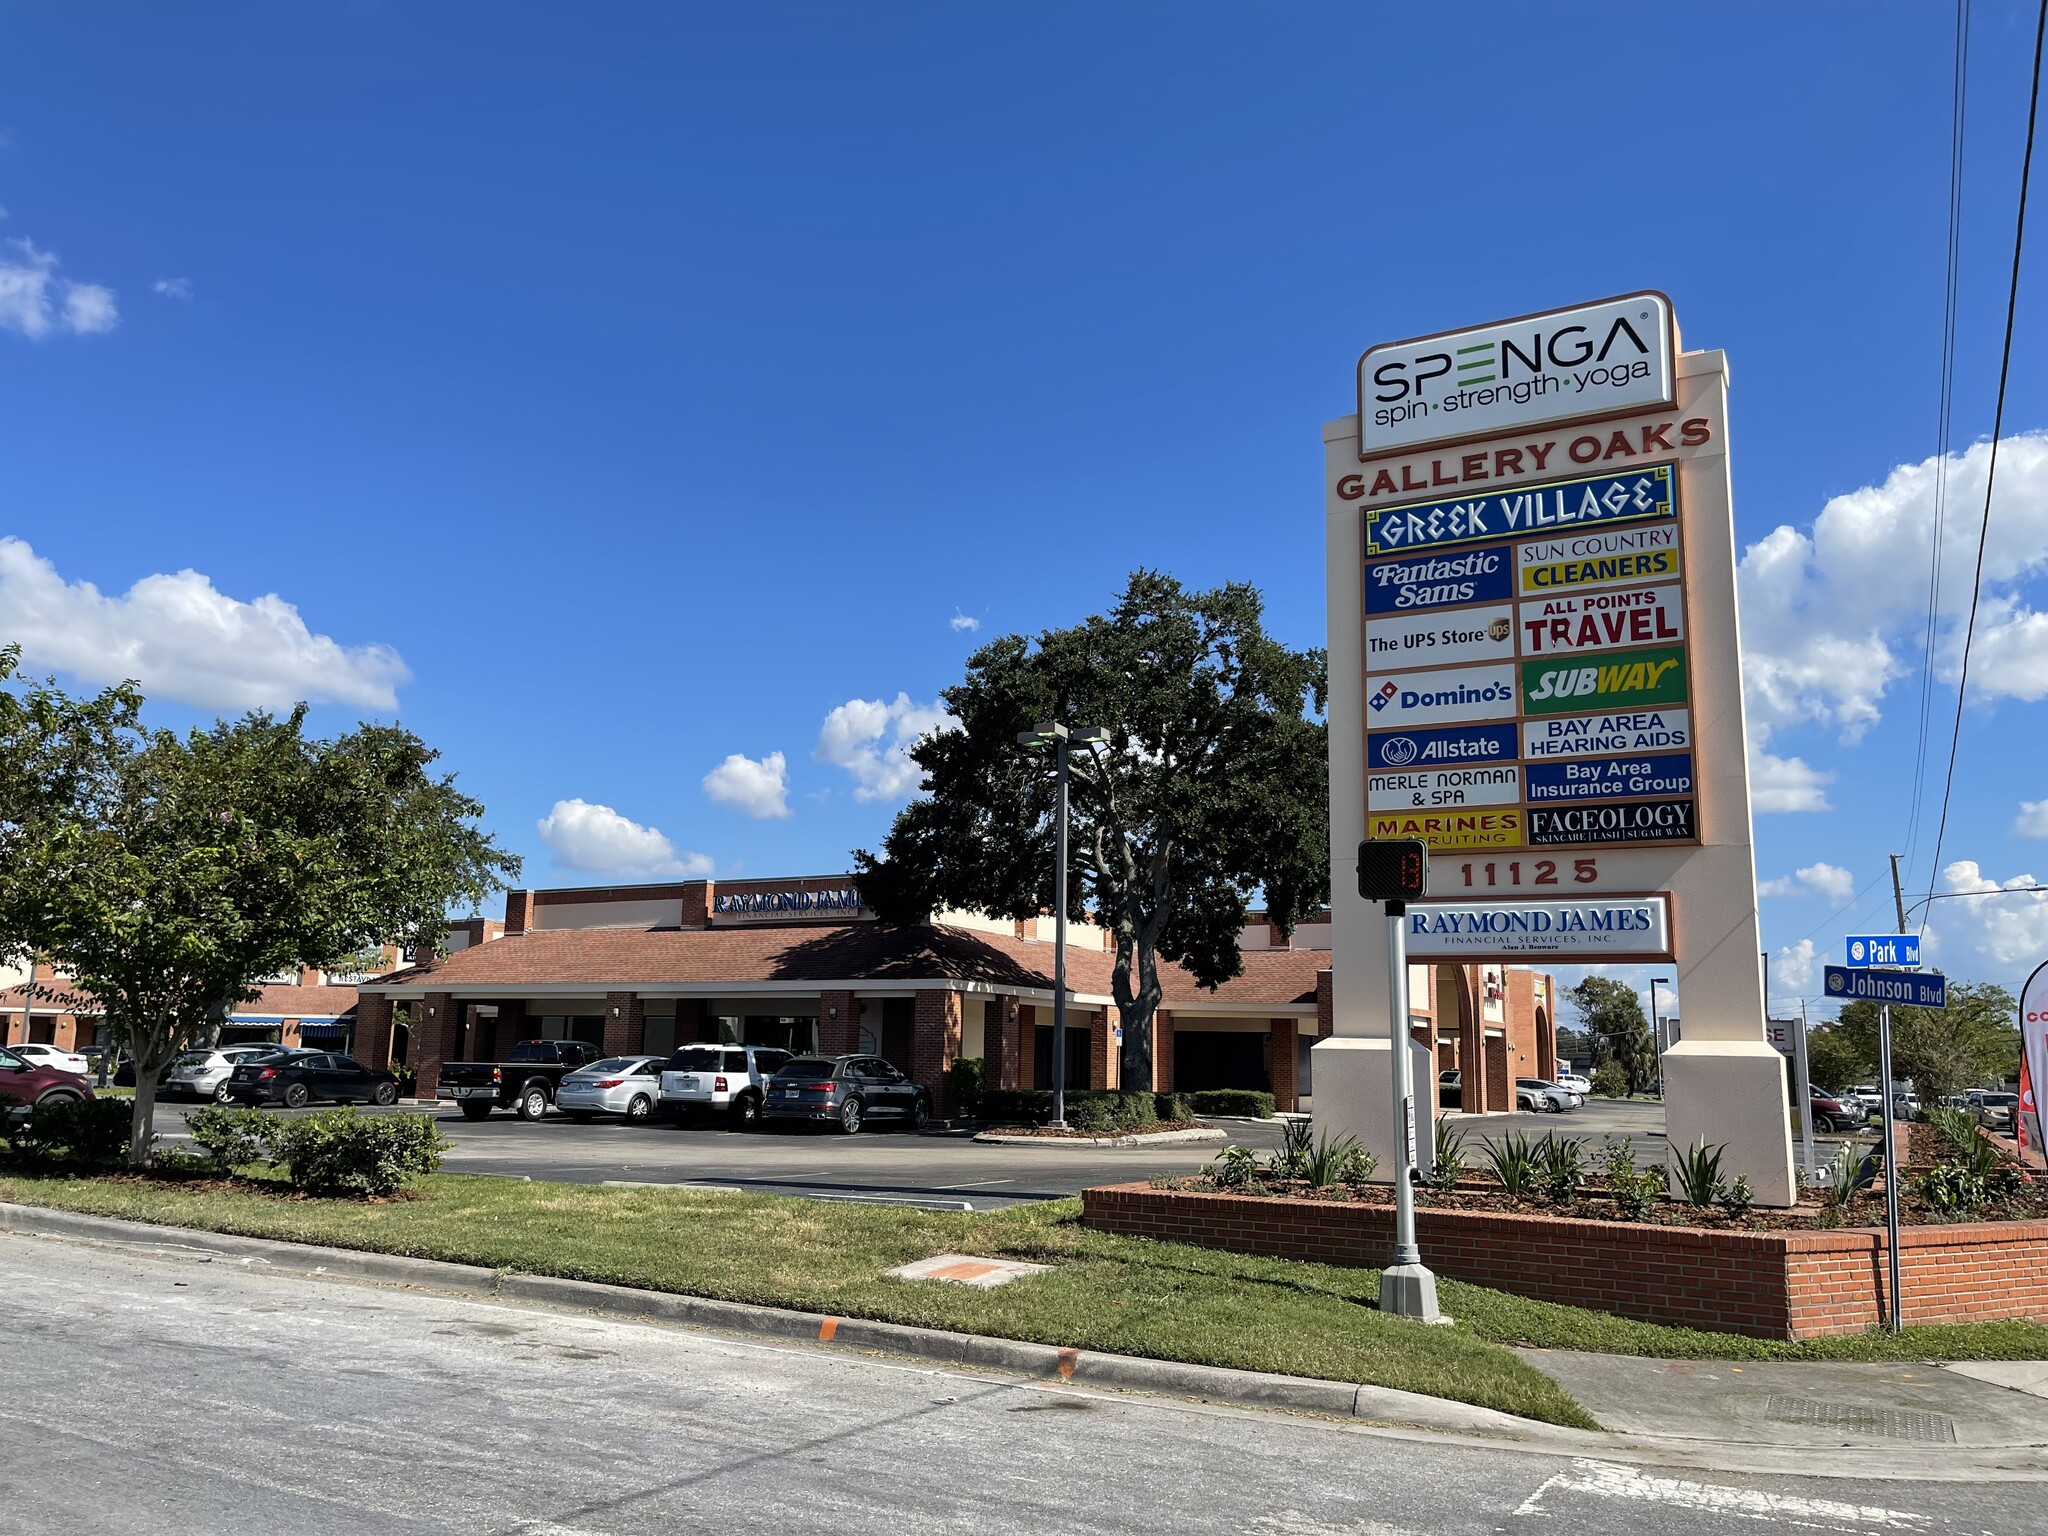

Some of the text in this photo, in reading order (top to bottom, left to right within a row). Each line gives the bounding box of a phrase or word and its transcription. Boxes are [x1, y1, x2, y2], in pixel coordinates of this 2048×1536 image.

[1373, 316, 1650, 402] SPENGA
[1375, 361, 1650, 427] spin strength yoga
[1336, 418, 1712, 500] GALLERY OAKS
[1380, 477, 1655, 547] GREEK VILLAGE
[1524, 528, 1674, 562] SUN COUNTRY
[1373, 552, 1499, 587] Fantastic
[1533, 552, 1668, 586] CLEANERS
[1395, 581, 1475, 608] Sams
[1543, 591, 1656, 616] ALL POINTS
[1369, 630, 1484, 652] The UPS Store
[1489, 624, 1510, 639] ups
[1525, 606, 1678, 652] TRAVEL
[1529, 657, 1679, 702] SUBWAY
[1401, 681, 1512, 709] Domino's
[1548, 713, 1665, 737] BAY AREA
[1421, 738, 1500, 759] Allstate
[1531, 731, 1686, 755] HEARING AIDS
[1369, 769, 1516, 791] MERLE NORMAN
[1566, 762, 1652, 781] Bay Area
[1412, 790, 1465, 806] & SPA
[1531, 776, 1690, 797] Insurance Group
[1377, 814, 1518, 836] MARINES
[1532, 804, 1691, 833] FACEOLOGY
[1420, 833, 1506, 845] RUITING
[1665, 827, 1688, 836] WAX
[1461, 858, 1598, 886] 11125
[713, 892, 813, 913] RAYMOND
[738, 911, 783, 919] FINANCIAL
[1411, 907, 1652, 934] RAYMOND JAMES
[1444, 936, 1511, 944] FINANCIAL
[1588, 934, 1616, 943] INC.
[1869, 940, 1919, 963] Park Blvd
[1847, 972, 1941, 1003] Johnson Blvd
